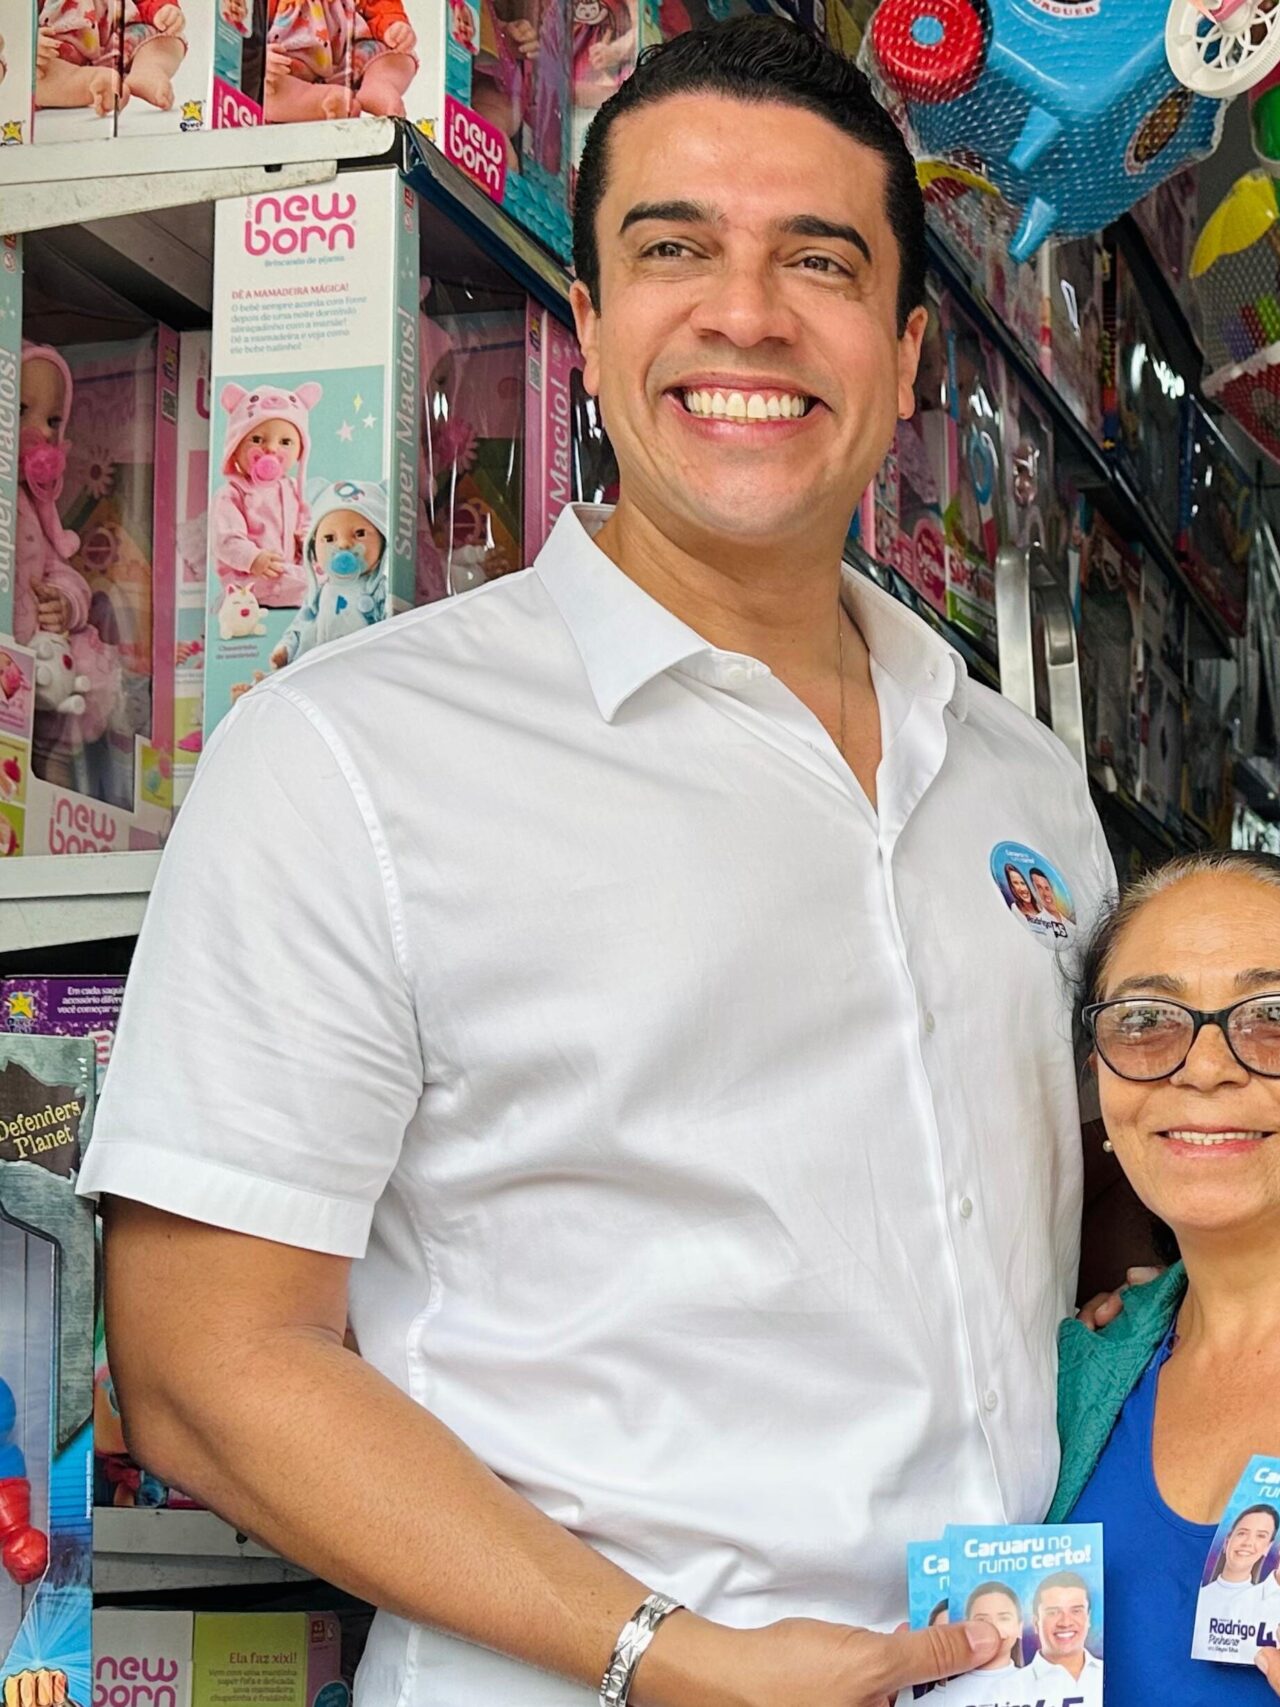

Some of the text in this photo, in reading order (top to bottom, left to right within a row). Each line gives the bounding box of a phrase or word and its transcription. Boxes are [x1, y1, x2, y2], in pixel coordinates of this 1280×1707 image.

[223, 94, 258, 128] ne
[455, 113, 503, 165] new
[450, 124, 500, 190] born
[255, 192, 357, 225] new
[244, 220, 355, 256] born
[245, 290, 253, 299] A
[253, 286, 309, 299] MAMADEIRA
[310, 282, 349, 295] MÁGICA!
[394, 305, 417, 561] Super Macios!
[549, 376, 569, 505] Macio!
[56, 798, 116, 842] new
[0, 1101, 81, 1141] Defenders
[13, 1124, 74, 1159] Planet
[964, 1535, 1072, 1558] Caruaru no
[978, 1544, 1092, 1575] rumo certo!
[1209, 1618, 1279, 1648] Rodrigo 4
[96, 1656, 178, 1682] new
[230, 1652, 297, 1664] Ela faz xixi!
